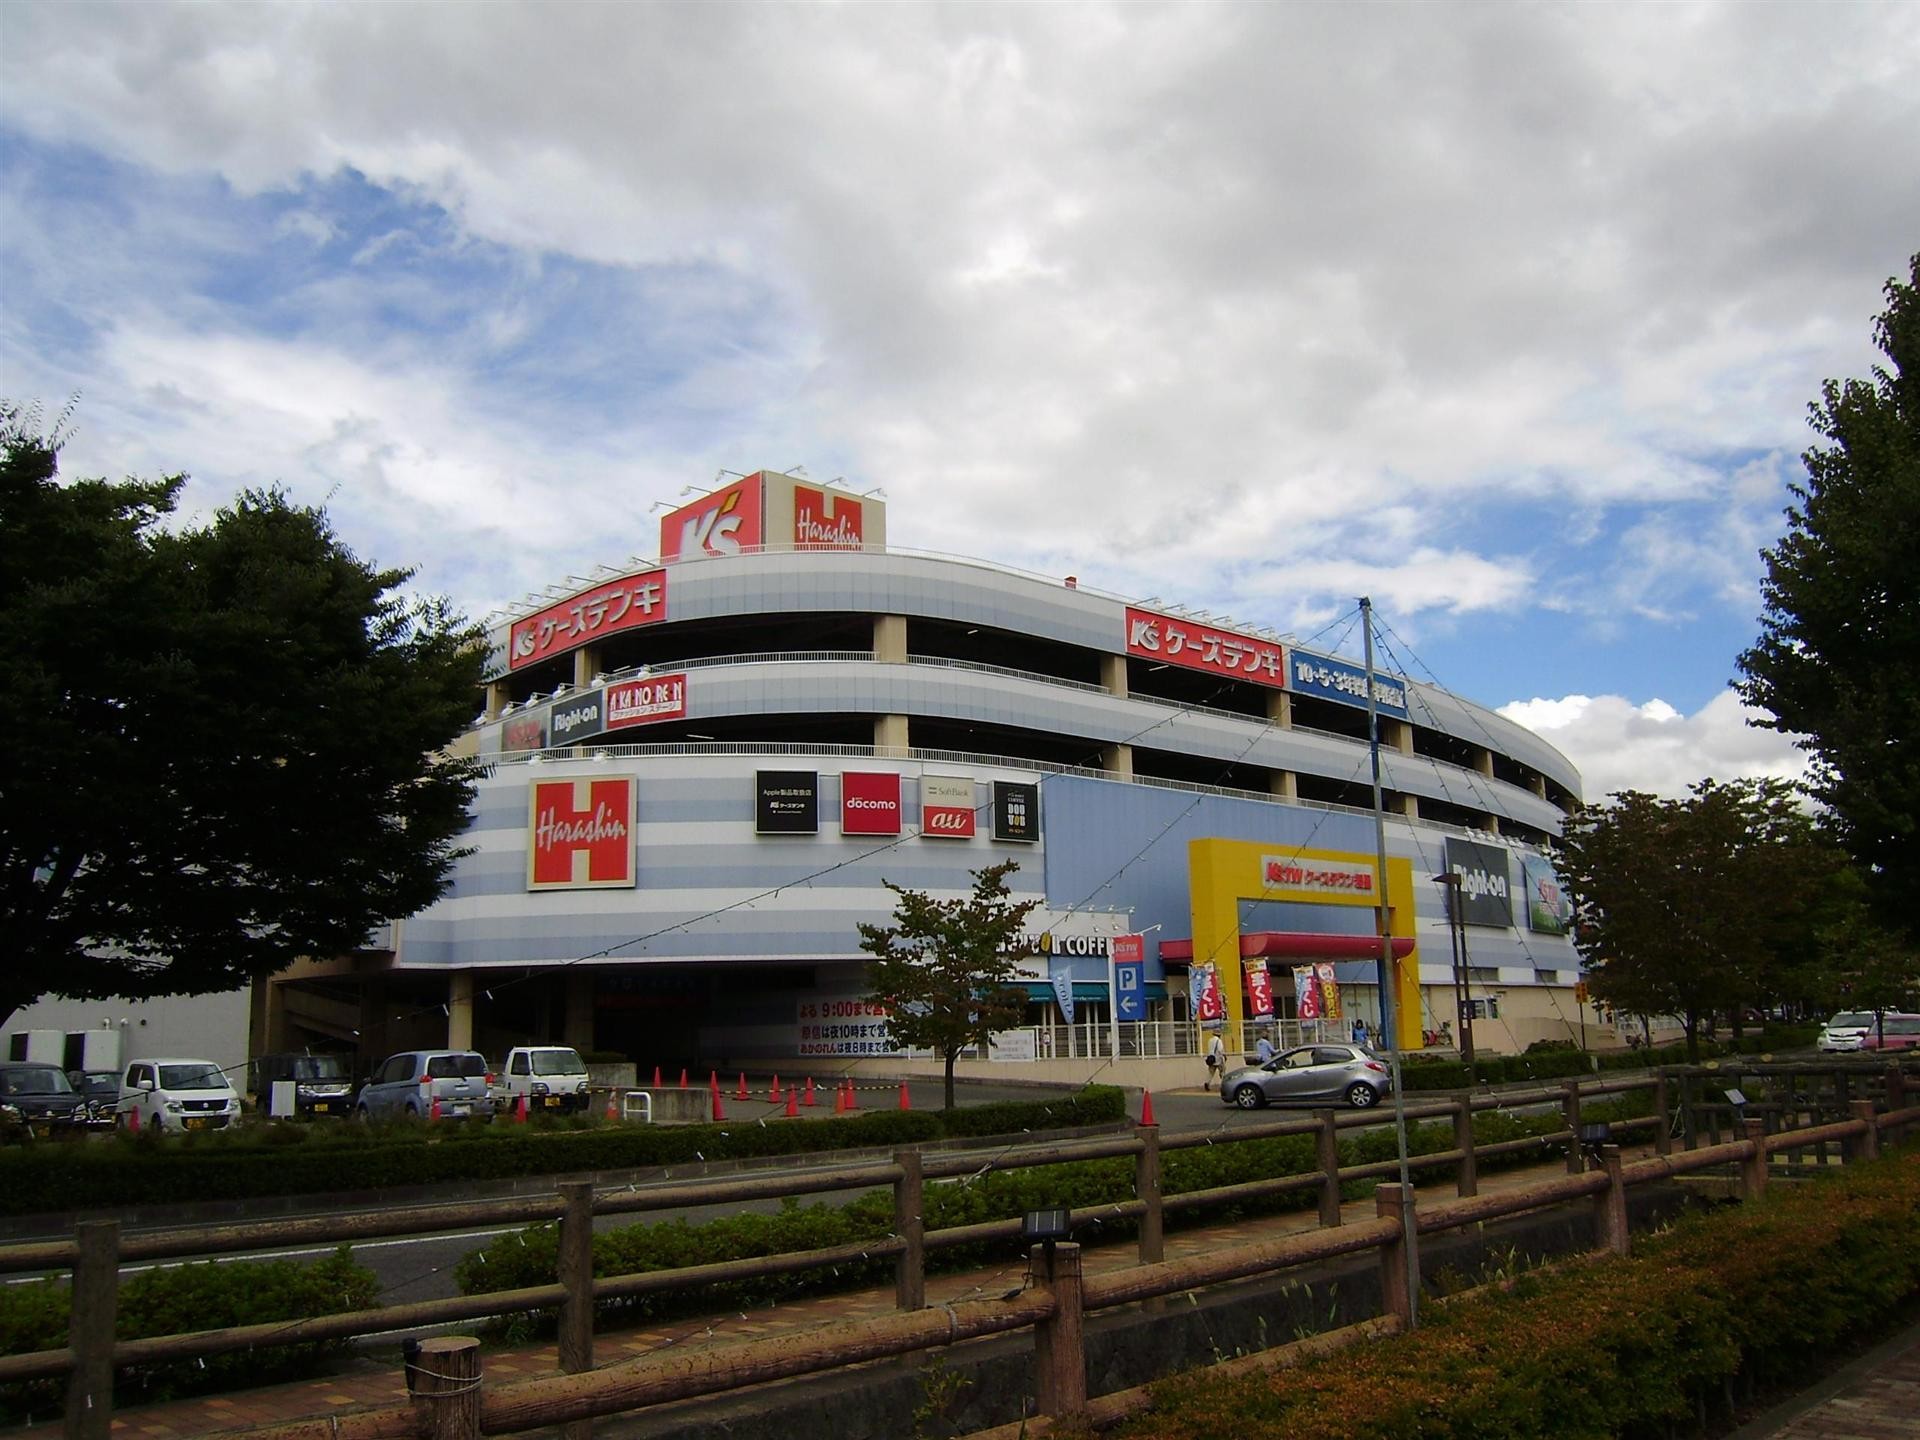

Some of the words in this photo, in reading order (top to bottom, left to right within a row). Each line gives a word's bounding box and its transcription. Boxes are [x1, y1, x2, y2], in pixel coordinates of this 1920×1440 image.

[679, 490, 743, 556] K's
[798, 508, 862, 547] Harashin
[513, 622, 537, 660] K's
[540, 582, 660, 649] ケーズデンキ
[1130, 618, 1160, 650] K's
[1165, 624, 1280, 677] ケーズデンキ
[555, 705, 598, 732] Right-on
[938, 787, 968, 797] SoftBank
[847, 797, 897, 810] docomo
[537, 801, 627, 853] Harashin
[931, 812, 967, 830] au
[1122, 971, 1133, 988] P
[802, 1024, 890, 1040] 原信は夜10時まで営
[801, 1041, 897, 1054] あかのれんは夜8時まで営
